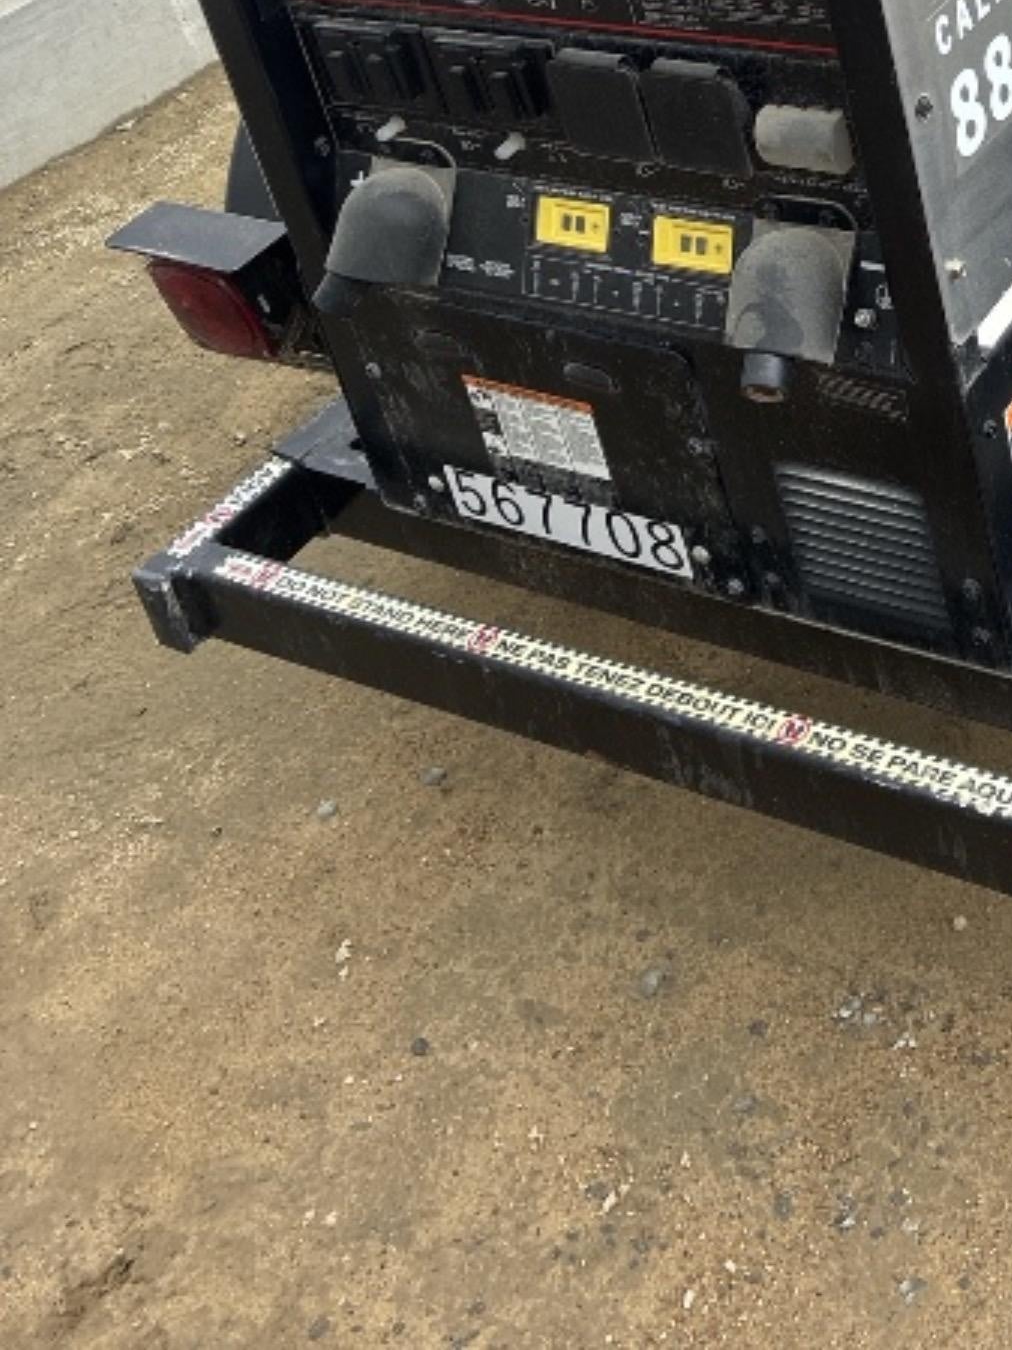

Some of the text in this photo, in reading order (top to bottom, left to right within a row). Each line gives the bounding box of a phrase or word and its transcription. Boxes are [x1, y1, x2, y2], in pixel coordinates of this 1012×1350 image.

[453, 469, 685, 571] 567708
[352, 596, 415, 629] STAND
[416, 612, 470, 640] HERE
[496, 637, 777, 733] NE PAS TENEZ DEBOUT ICI
[808, 731, 849, 753] NO
[852, 743, 886, 764] SE
[887, 753, 958, 787] PARE
